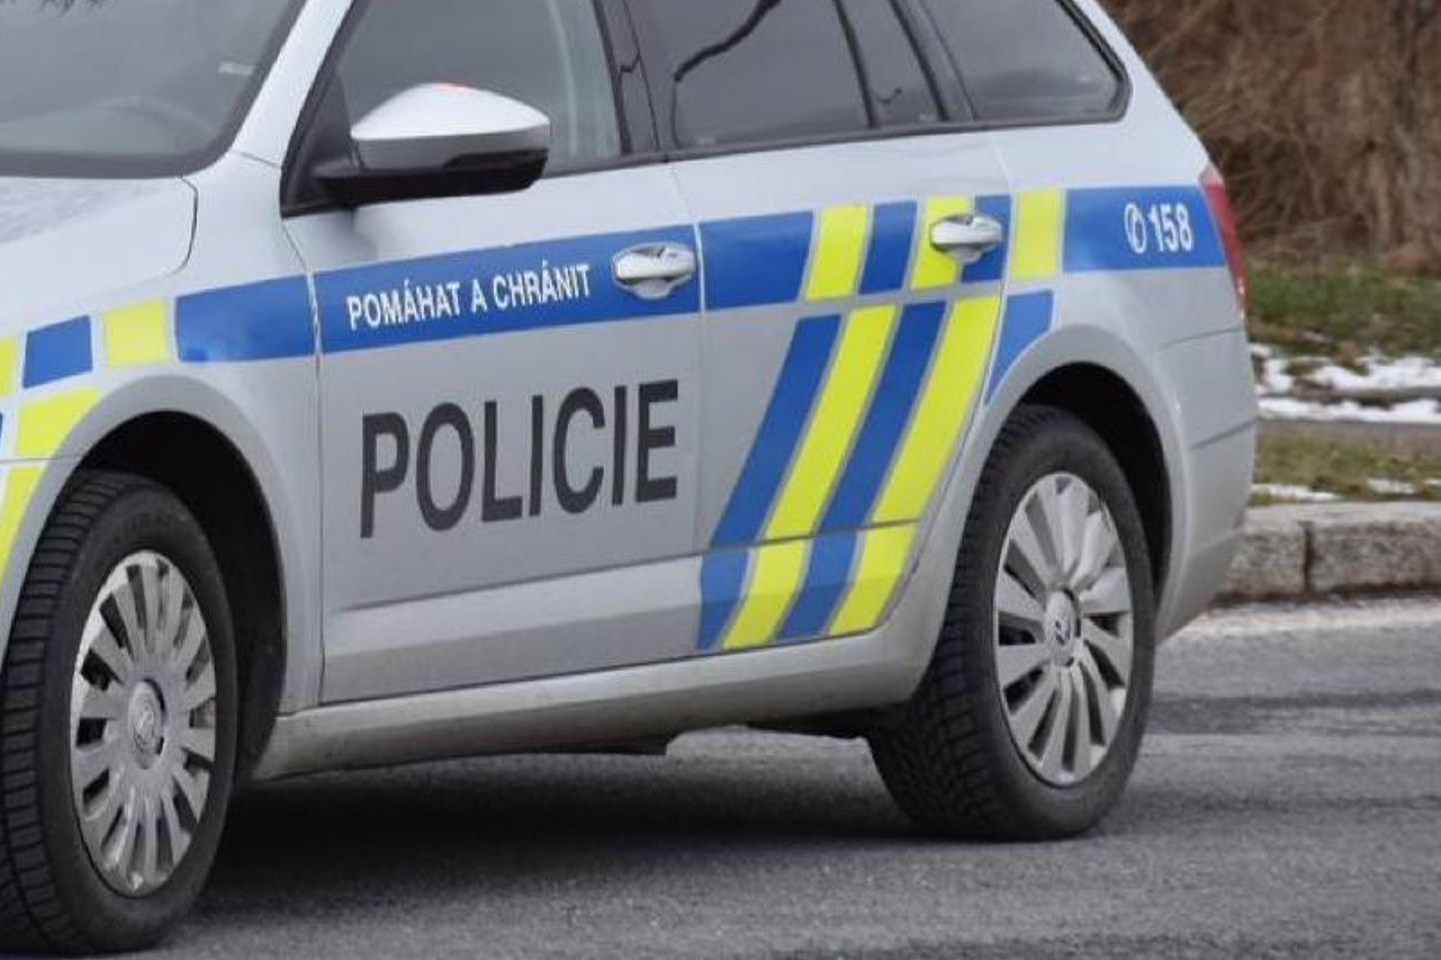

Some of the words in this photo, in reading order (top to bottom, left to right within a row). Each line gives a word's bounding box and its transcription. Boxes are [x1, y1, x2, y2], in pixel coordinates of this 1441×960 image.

[1148, 202, 1192, 252] 158
[347, 279, 460, 331] POMÁHAT
[471, 278, 488, 314] A
[493, 259, 591, 307] CHRÁNIT
[360, 378, 679, 539] POLICIE
